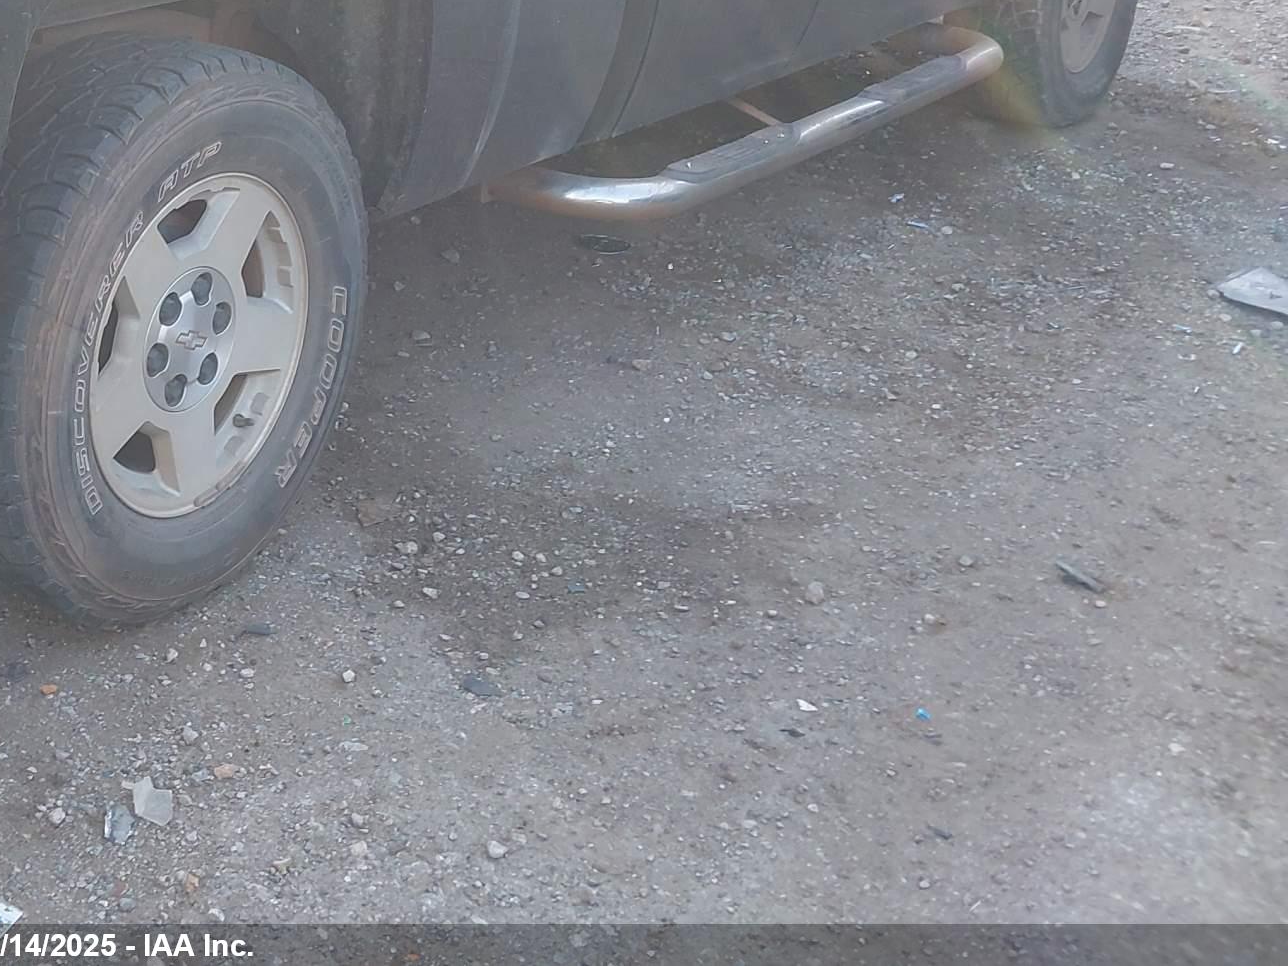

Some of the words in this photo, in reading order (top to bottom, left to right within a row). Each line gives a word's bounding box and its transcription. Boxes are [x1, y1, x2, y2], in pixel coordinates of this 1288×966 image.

[72, 210, 144, 516] DISCOVERER
[158, 141, 223, 202] ATP
[275, 285, 348, 489] COOPER
